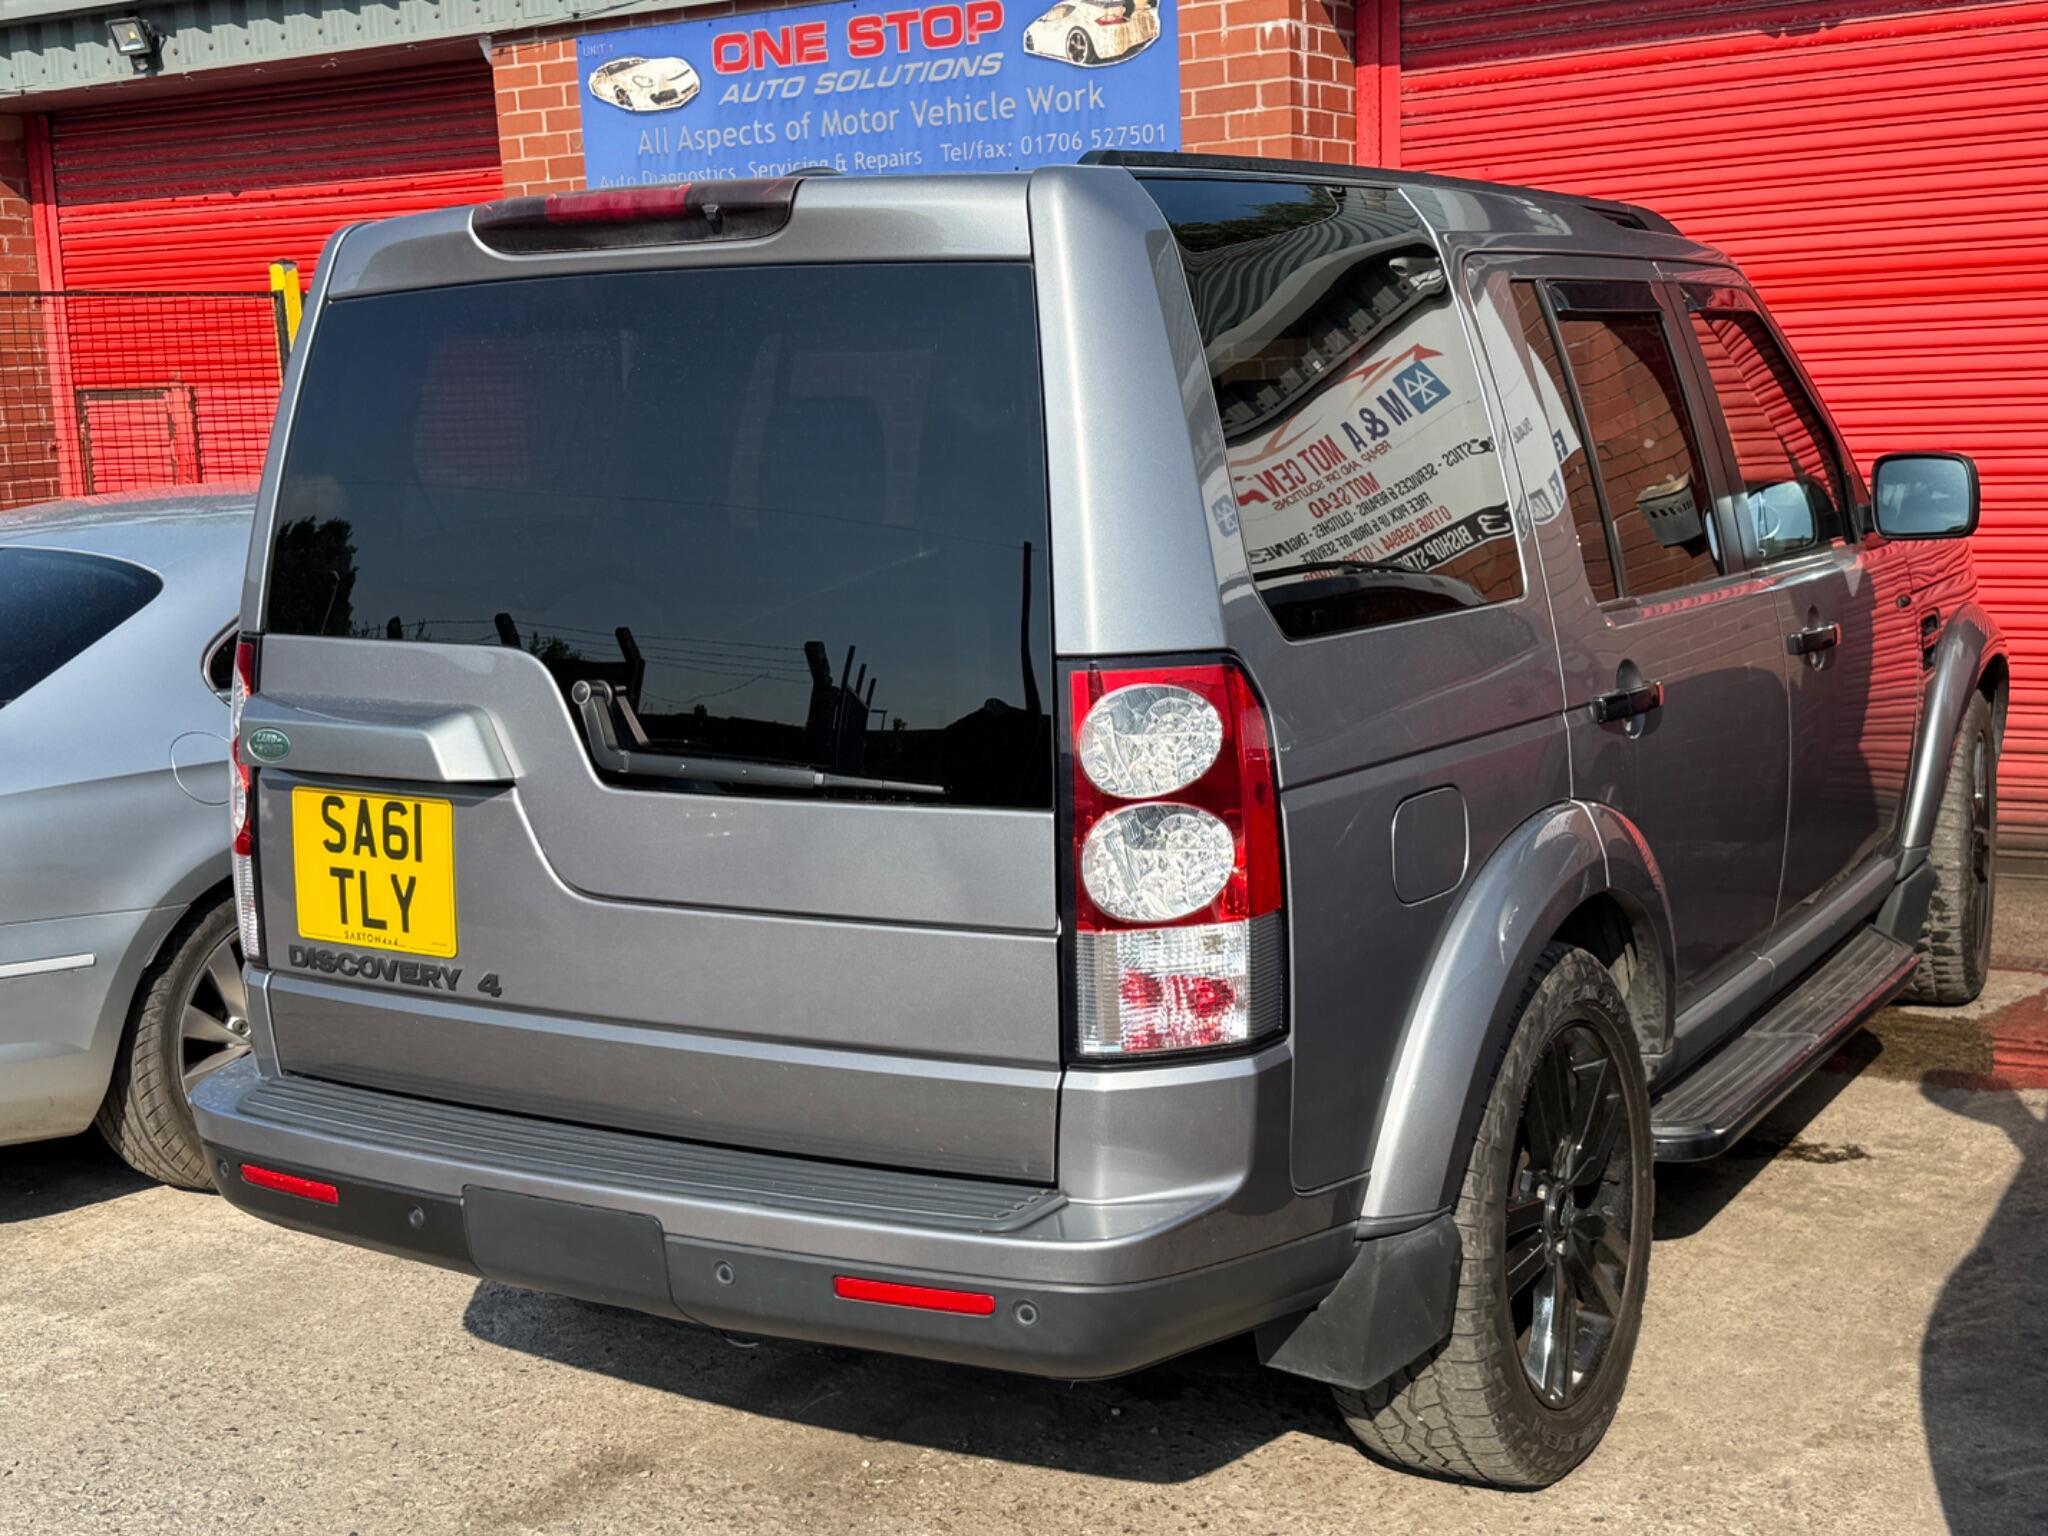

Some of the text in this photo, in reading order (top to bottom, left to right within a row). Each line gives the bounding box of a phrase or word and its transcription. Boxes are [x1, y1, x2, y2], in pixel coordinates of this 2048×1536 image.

[582, 43, 606, 57] UNIT
[711, 0, 1005, 76] ONE STOP
[718, 52, 1004, 105] AUTO SOLUTIONS
[637, 79, 1106, 156] All Aspects of Motor Vehicle Work
[600, 174, 637, 189] Auto
[641, 165, 736, 186] Diagnostics
[834, 152, 849, 172] &
[854, 149, 923, 171] Repairs
[940, 139, 1014, 164] Tel/fax:
[1020, 131, 1083, 157] 01706
[1091, 123, 1166, 149] 527501
[321, 795, 423, 863] SA61
[329, 866, 417, 934] TLY
[288, 944, 503, 998] DISCOVERY 4
